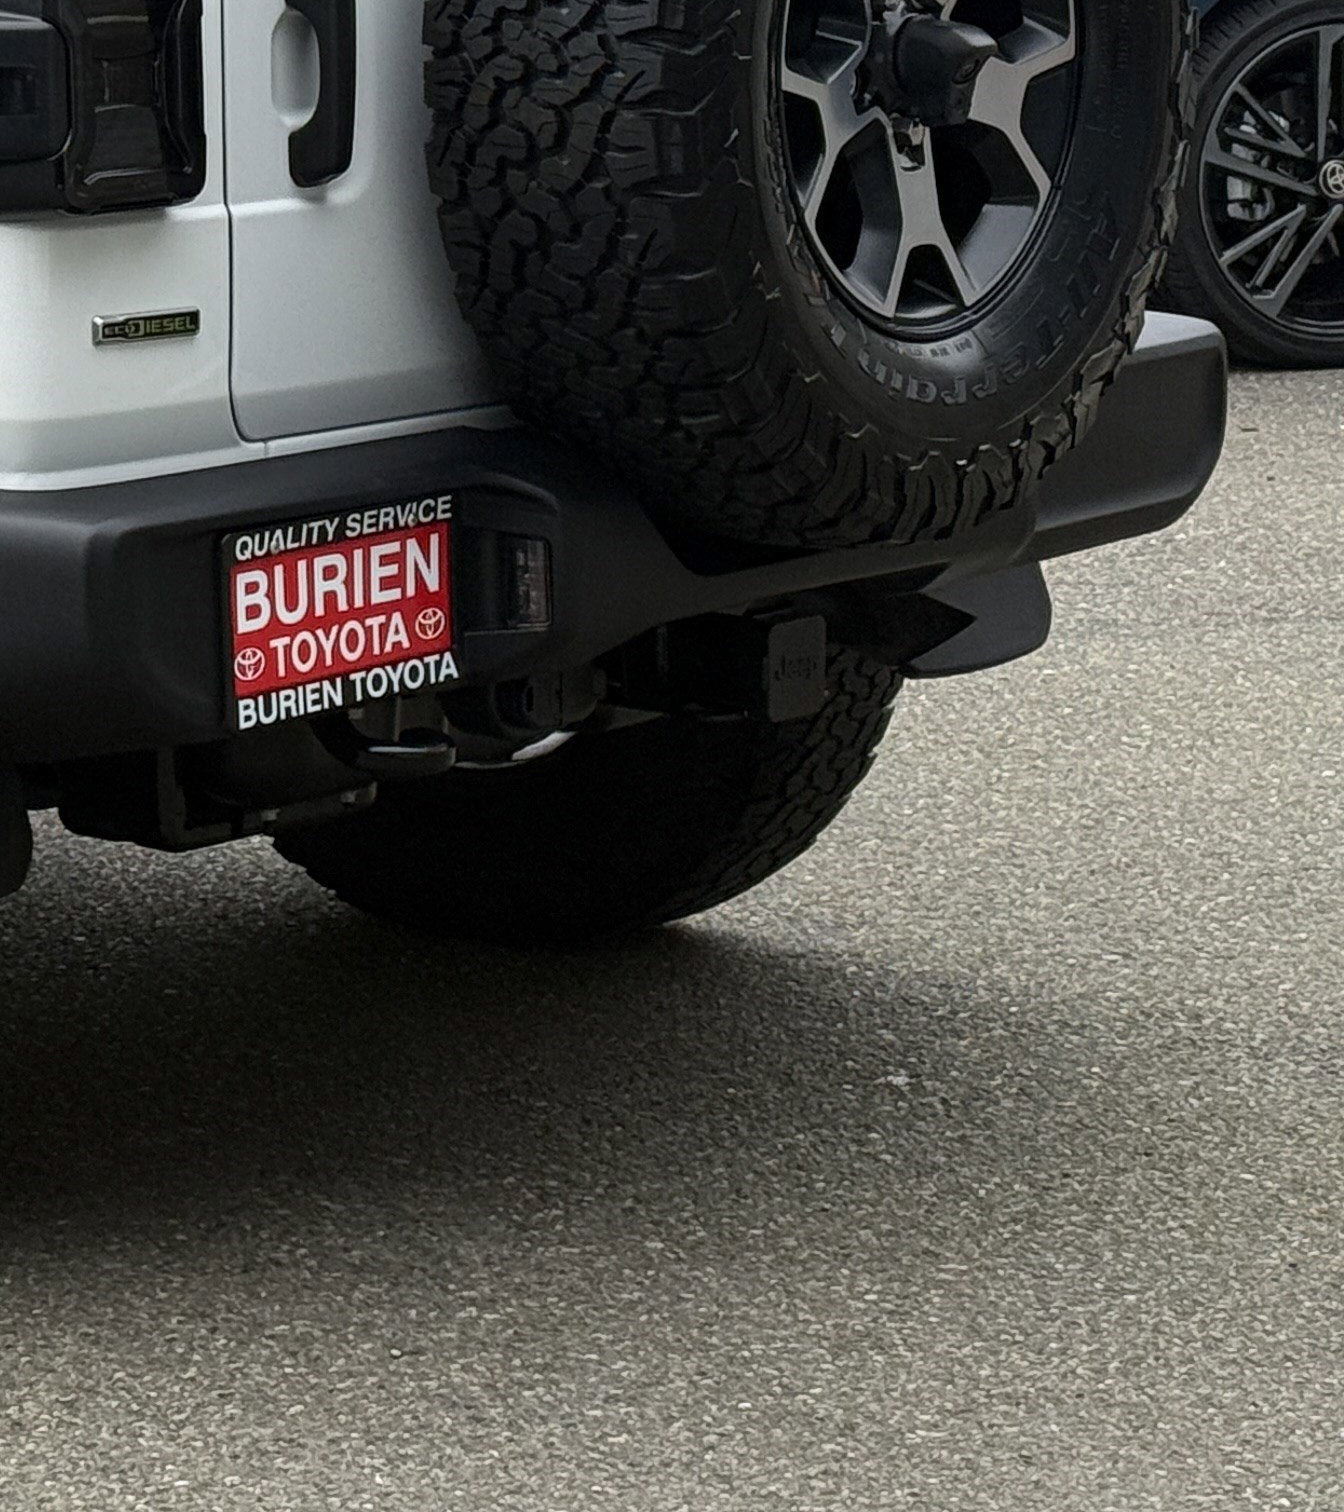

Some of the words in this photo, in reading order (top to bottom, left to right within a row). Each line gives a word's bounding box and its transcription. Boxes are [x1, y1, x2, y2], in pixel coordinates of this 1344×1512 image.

[235, 517, 340, 562] QUALITY
[345, 495, 453, 538] SERVICE
[236, 533, 440, 635] BURIEN
[269, 611, 411, 678] TOYOTA
[238, 677, 344, 731] BURIEN
[349, 651, 460, 703] TOYOTA
